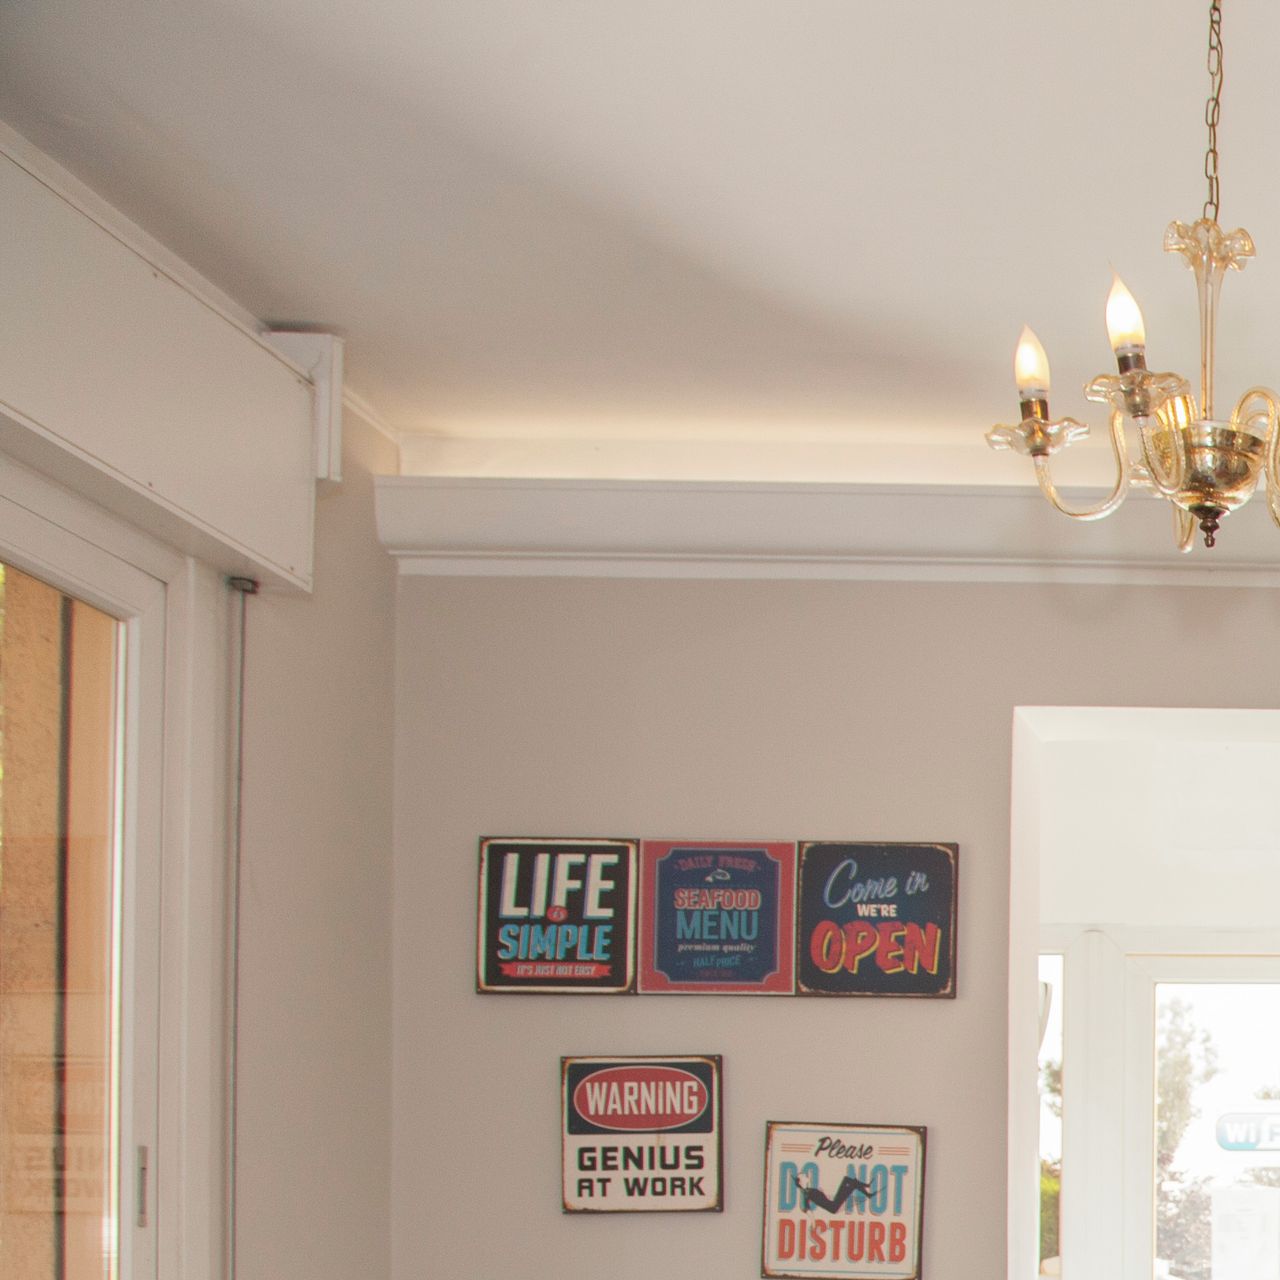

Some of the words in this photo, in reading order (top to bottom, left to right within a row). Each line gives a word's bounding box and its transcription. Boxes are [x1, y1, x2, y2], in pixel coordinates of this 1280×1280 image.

[499, 852, 619, 919] LIFE
[674, 887, 762, 910] SEAFOOD
[824, 858, 898, 908] Come
[905, 870, 929, 895] in
[676, 910, 759, 940] MENU
[856, 903, 897, 917] WE'RE
[497, 923, 613, 961] SIMPLE
[678, 943, 720, 953] premium
[722, 943, 755, 954] quality
[809, 920, 941, 975] OPEN
[585, 1080, 699, 1116] WARNING
[577, 1145, 705, 1171] GENIUS
[814, 1136, 874, 1160] Please
[577, 1178, 612, 1197] AT
[624, 1177, 706, 1197] WORK
[777, 1161, 820, 1213] DO
[845, 1163, 909, 1217] NOT
[777, 1218, 907, 1264] DISTURB
